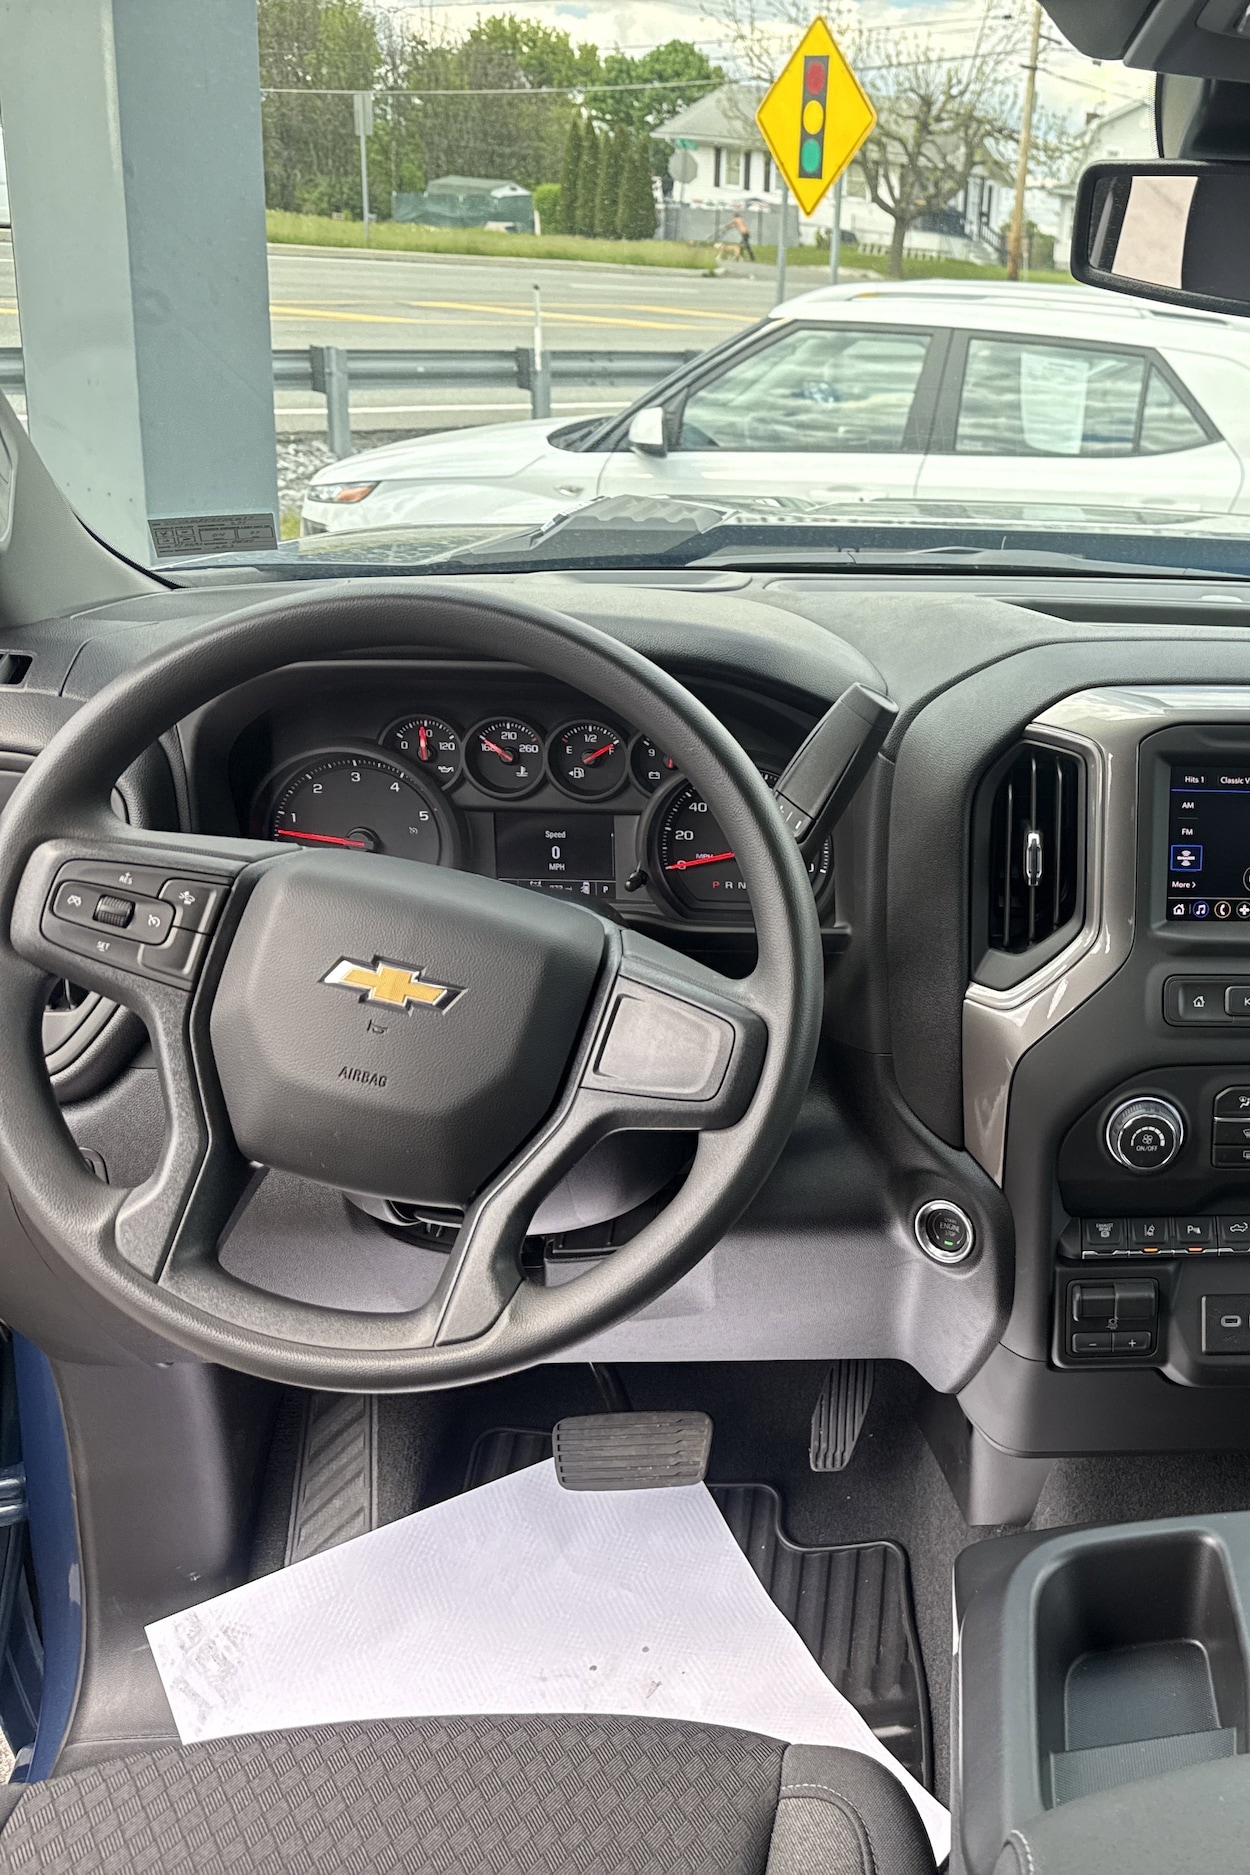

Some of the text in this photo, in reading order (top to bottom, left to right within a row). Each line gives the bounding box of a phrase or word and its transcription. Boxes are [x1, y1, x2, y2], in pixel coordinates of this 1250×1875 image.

[500, 731, 517, 740] 210
[584, 734, 598, 743] 1/2
[438, 742, 456, 750] 120
[518, 744, 538, 753] 260
[566, 746, 573, 754] E
[648, 749, 656, 757] 9
[351, 772, 361, 782] 3
[1184, 776, 1200, 784] Hits
[1220, 776, 1244, 785] Classic
[313, 783, 323, 794] 2
[390, 782, 400, 792] 4
[688, 802, 708, 812] 40
[291, 812, 296, 823] 1
[419, 810, 430, 821] 5
[545, 830, 566, 840] Speed
[675, 830, 694, 840] 20
[552, 846, 560, 860] 0
[548, 862, 566, 871] MPH
[119, 876, 132, 885] RES
[712, 880, 747, 890] P R N
[1172, 881, 1190, 889] More
[96, 941, 110, 950] SET
[338, 1066, 388, 1088] AIRBAG
